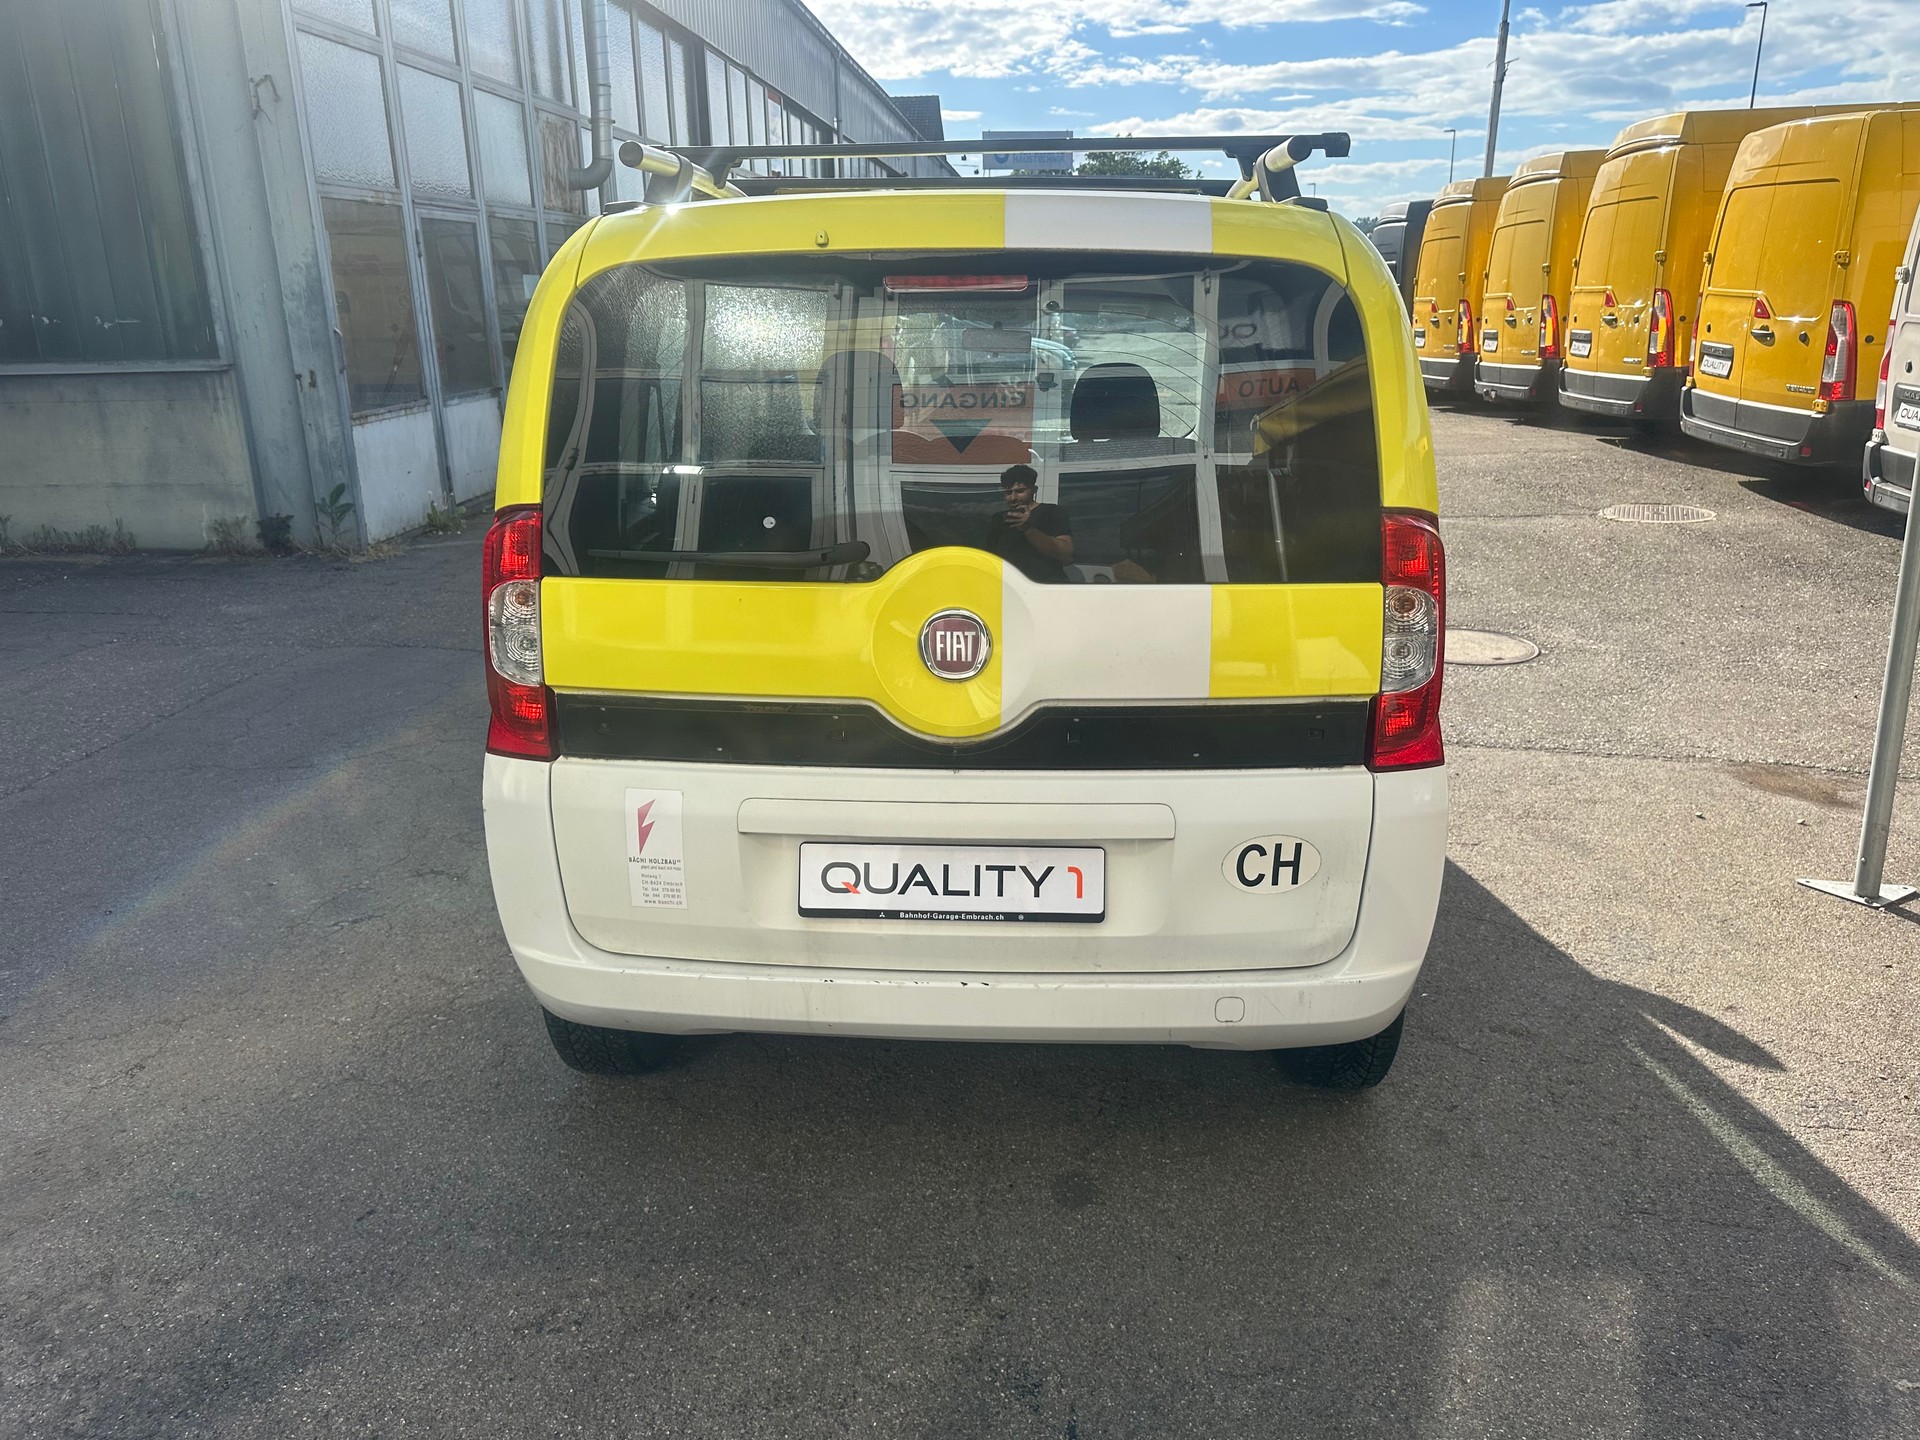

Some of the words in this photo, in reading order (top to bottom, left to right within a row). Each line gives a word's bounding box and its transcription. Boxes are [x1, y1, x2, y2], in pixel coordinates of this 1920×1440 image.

[1901, 407, 1920, 422] QUA
[936, 630, 976, 662] FIAT
[820, 861, 1056, 899] QUALITY
[1067, 865, 1083, 899] 1
[1236, 842, 1303, 887] CH
[899, 912, 1005, 920] Bahnhof-Garage-Embrach.ch
